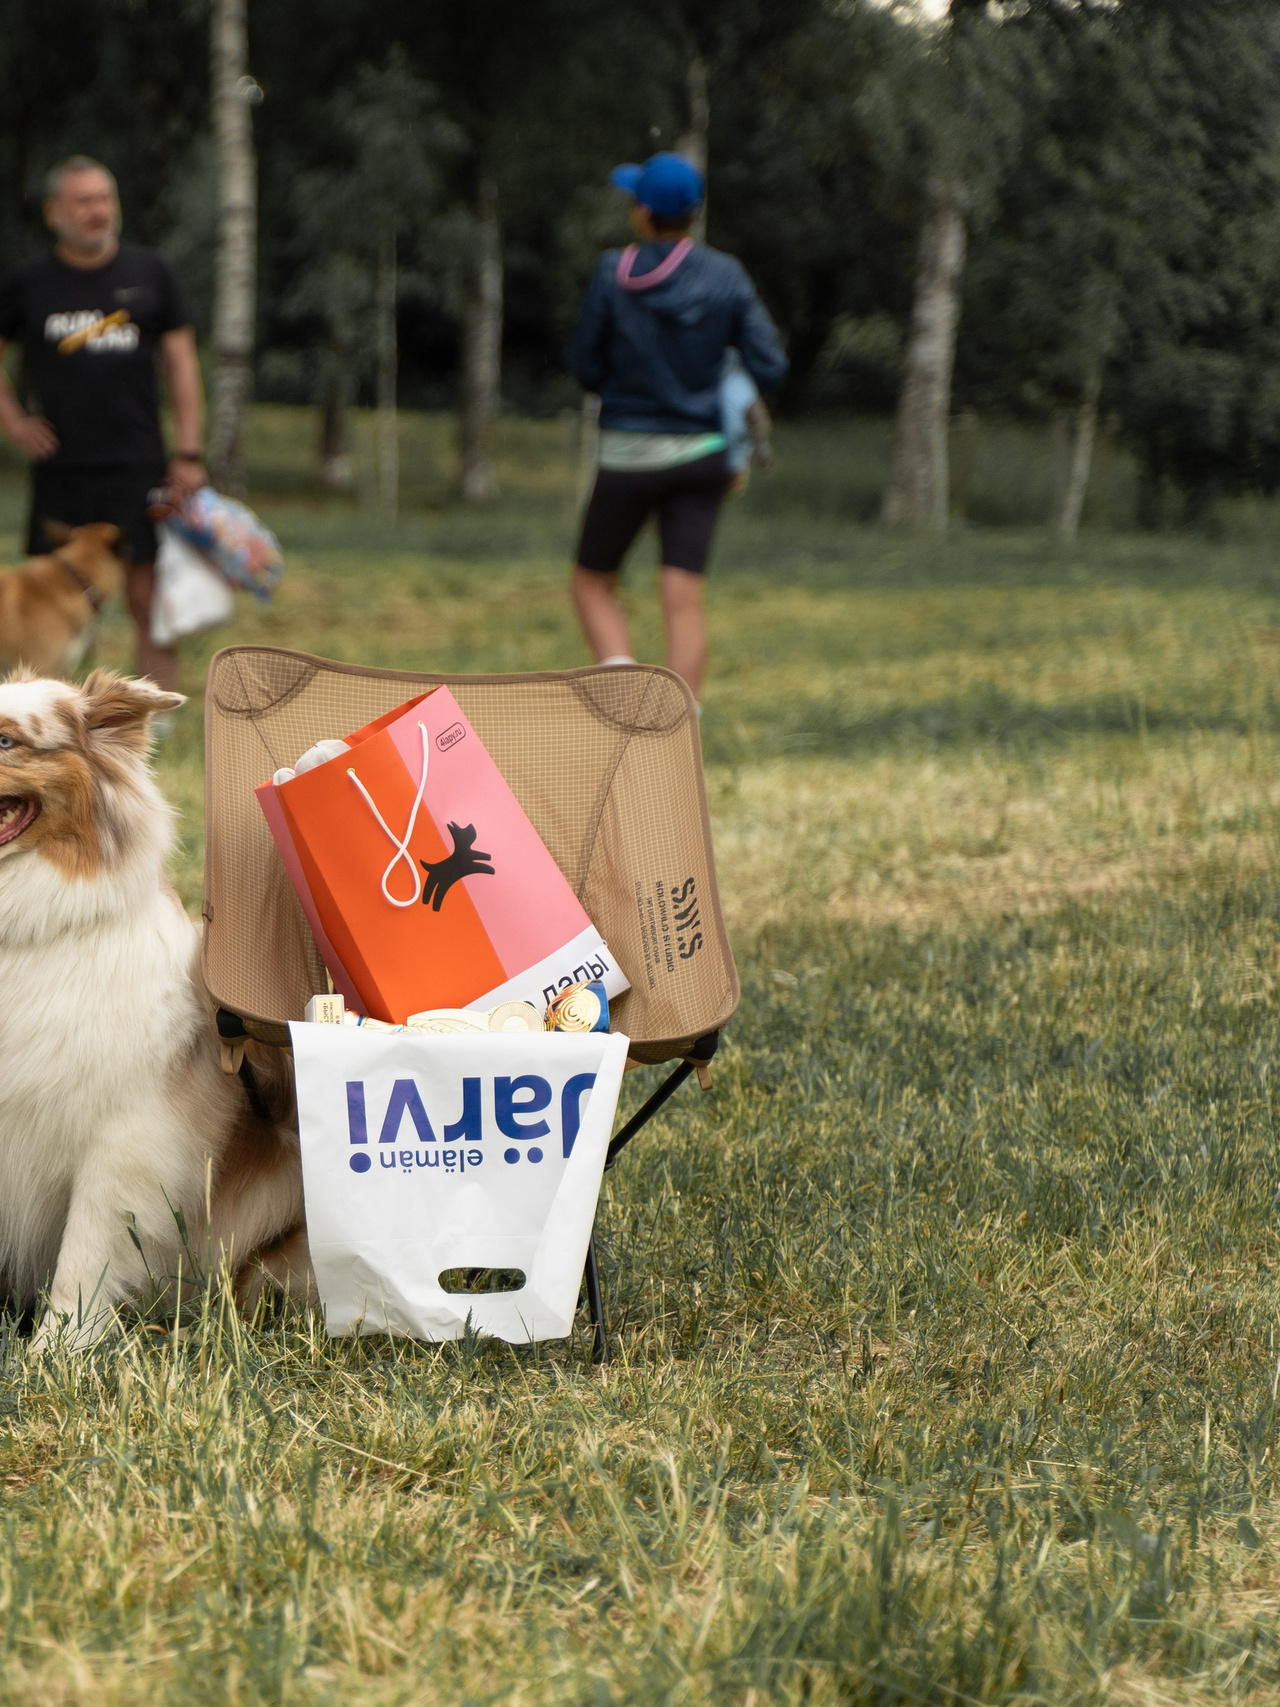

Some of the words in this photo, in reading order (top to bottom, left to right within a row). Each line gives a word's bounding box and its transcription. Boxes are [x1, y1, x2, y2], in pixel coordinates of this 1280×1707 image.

[439, 726, 463, 748] 4lapy.ru
[656, 880, 669, 932] SOLOWILD
[663, 935, 675, 973] STUDIO
[379, 1148, 484, 1174] elämän
